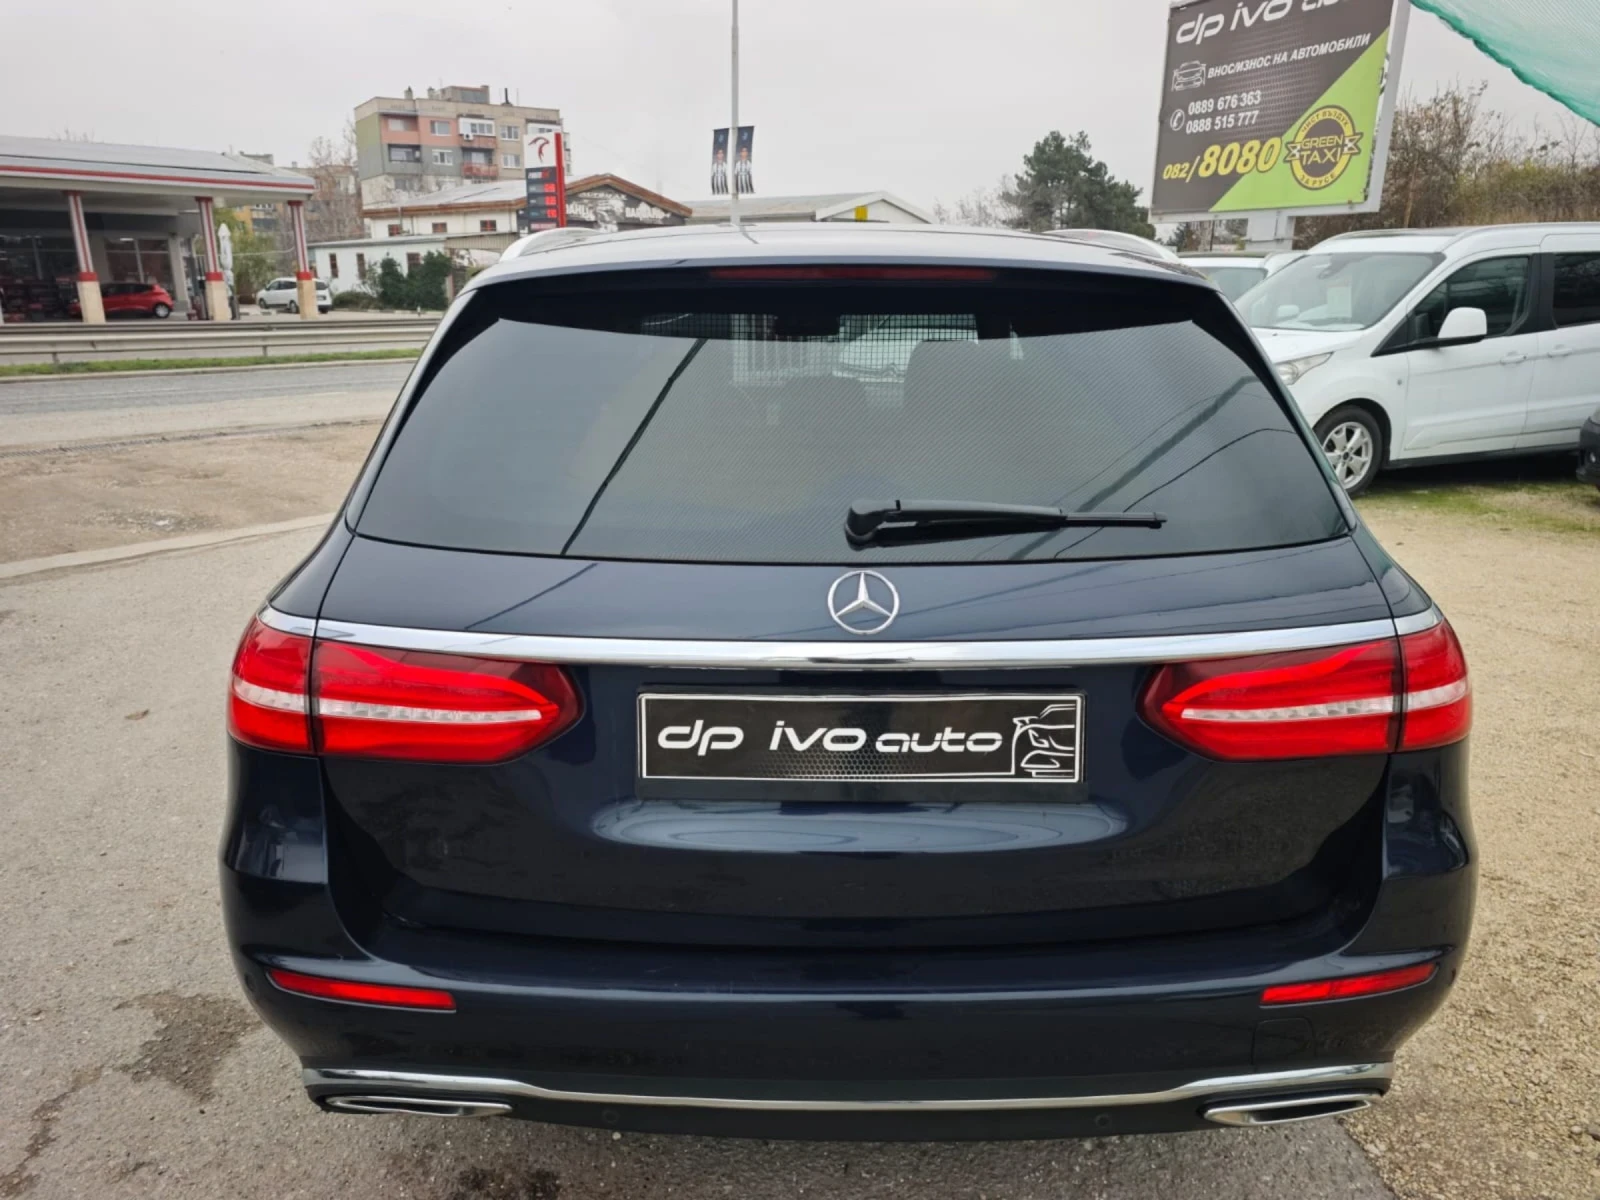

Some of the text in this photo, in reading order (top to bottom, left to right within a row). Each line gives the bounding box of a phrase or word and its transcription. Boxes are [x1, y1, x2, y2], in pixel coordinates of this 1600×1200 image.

[1175, 13, 1225, 45] dp
[1229, 0, 1293, 31] ivo
[1207, 32, 1372, 79] ВНОС/ИЗНОС НА АВТОМОБИЛИ
[1187, 98, 1215, 116] 0889
[1216, 94, 1238, 111] 676
[1185, 110, 1260, 134] 0888 515 777
[1301, 133, 1344, 150] GREEN
[1300, 147, 1342, 166] TAXI
[657, 719, 1003, 756] dp ivo auto
